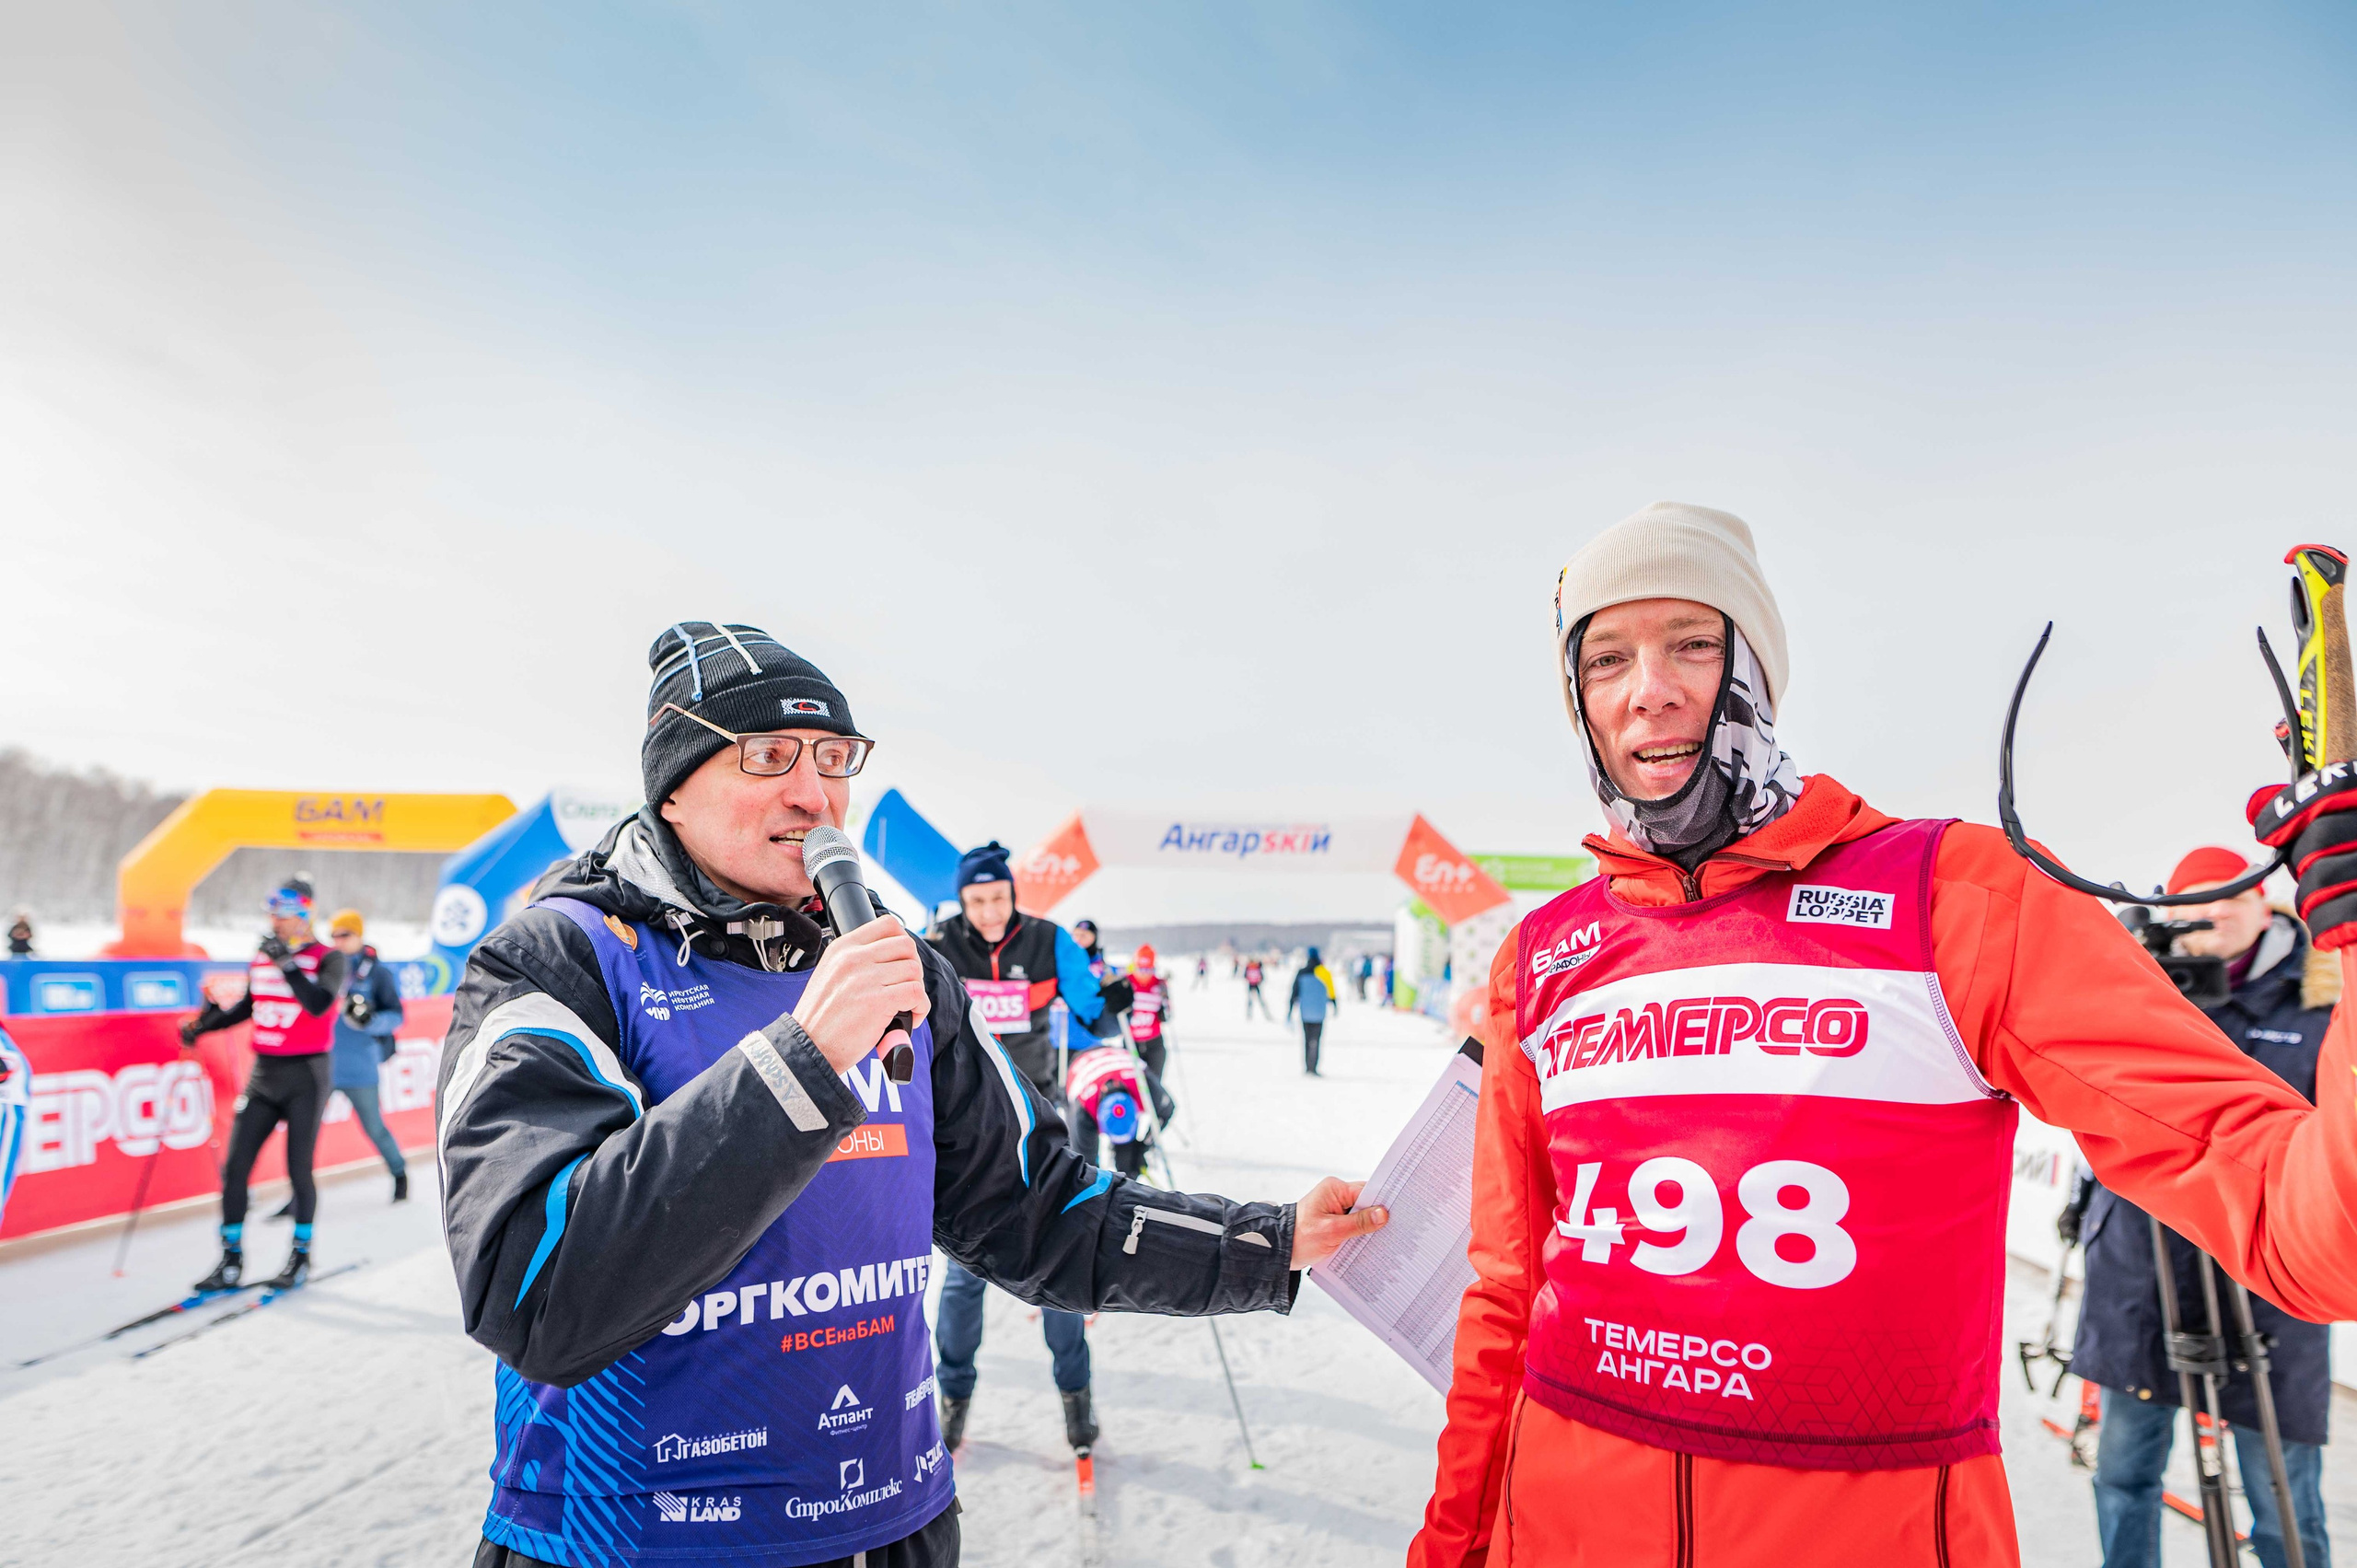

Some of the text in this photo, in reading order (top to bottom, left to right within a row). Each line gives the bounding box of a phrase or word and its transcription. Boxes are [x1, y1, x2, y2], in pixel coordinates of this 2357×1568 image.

[2300, 689, 2316, 765] LEKI
[1795, 904, 1884, 923] LOPPET
[1798, 890, 1885, 911] RUSSIA
[1532, 921, 1601, 974] БАМ
[668, 984, 710, 998] ИРКУТСКАЯ
[671, 991, 710, 1005] НЕФТЯНАЯ
[674, 997, 715, 1011] КОМПАНИЯ
[1542, 996, 1869, 1079] ТЕМЕРСО
[840, 1058, 902, 1112] М
[23, 1060, 216, 1176] ЕРСО
[837, 1131, 884, 1154] ОНЫ
[1557, 1156, 1857, 1289] 498
[781, 1315, 895, 1353] #ВСЕнаБАМ
[1585, 1318, 1772, 1371] ТЕМЕРСО
[1596, 1351, 1755, 1400] АНГАРА
[818, 1407, 874, 1430] Атлант
[682, 1430, 768, 1459] ГАЗОБЕТОН
[690, 1506, 741, 1522] LAND
[691, 1496, 741, 1507] KRAS
